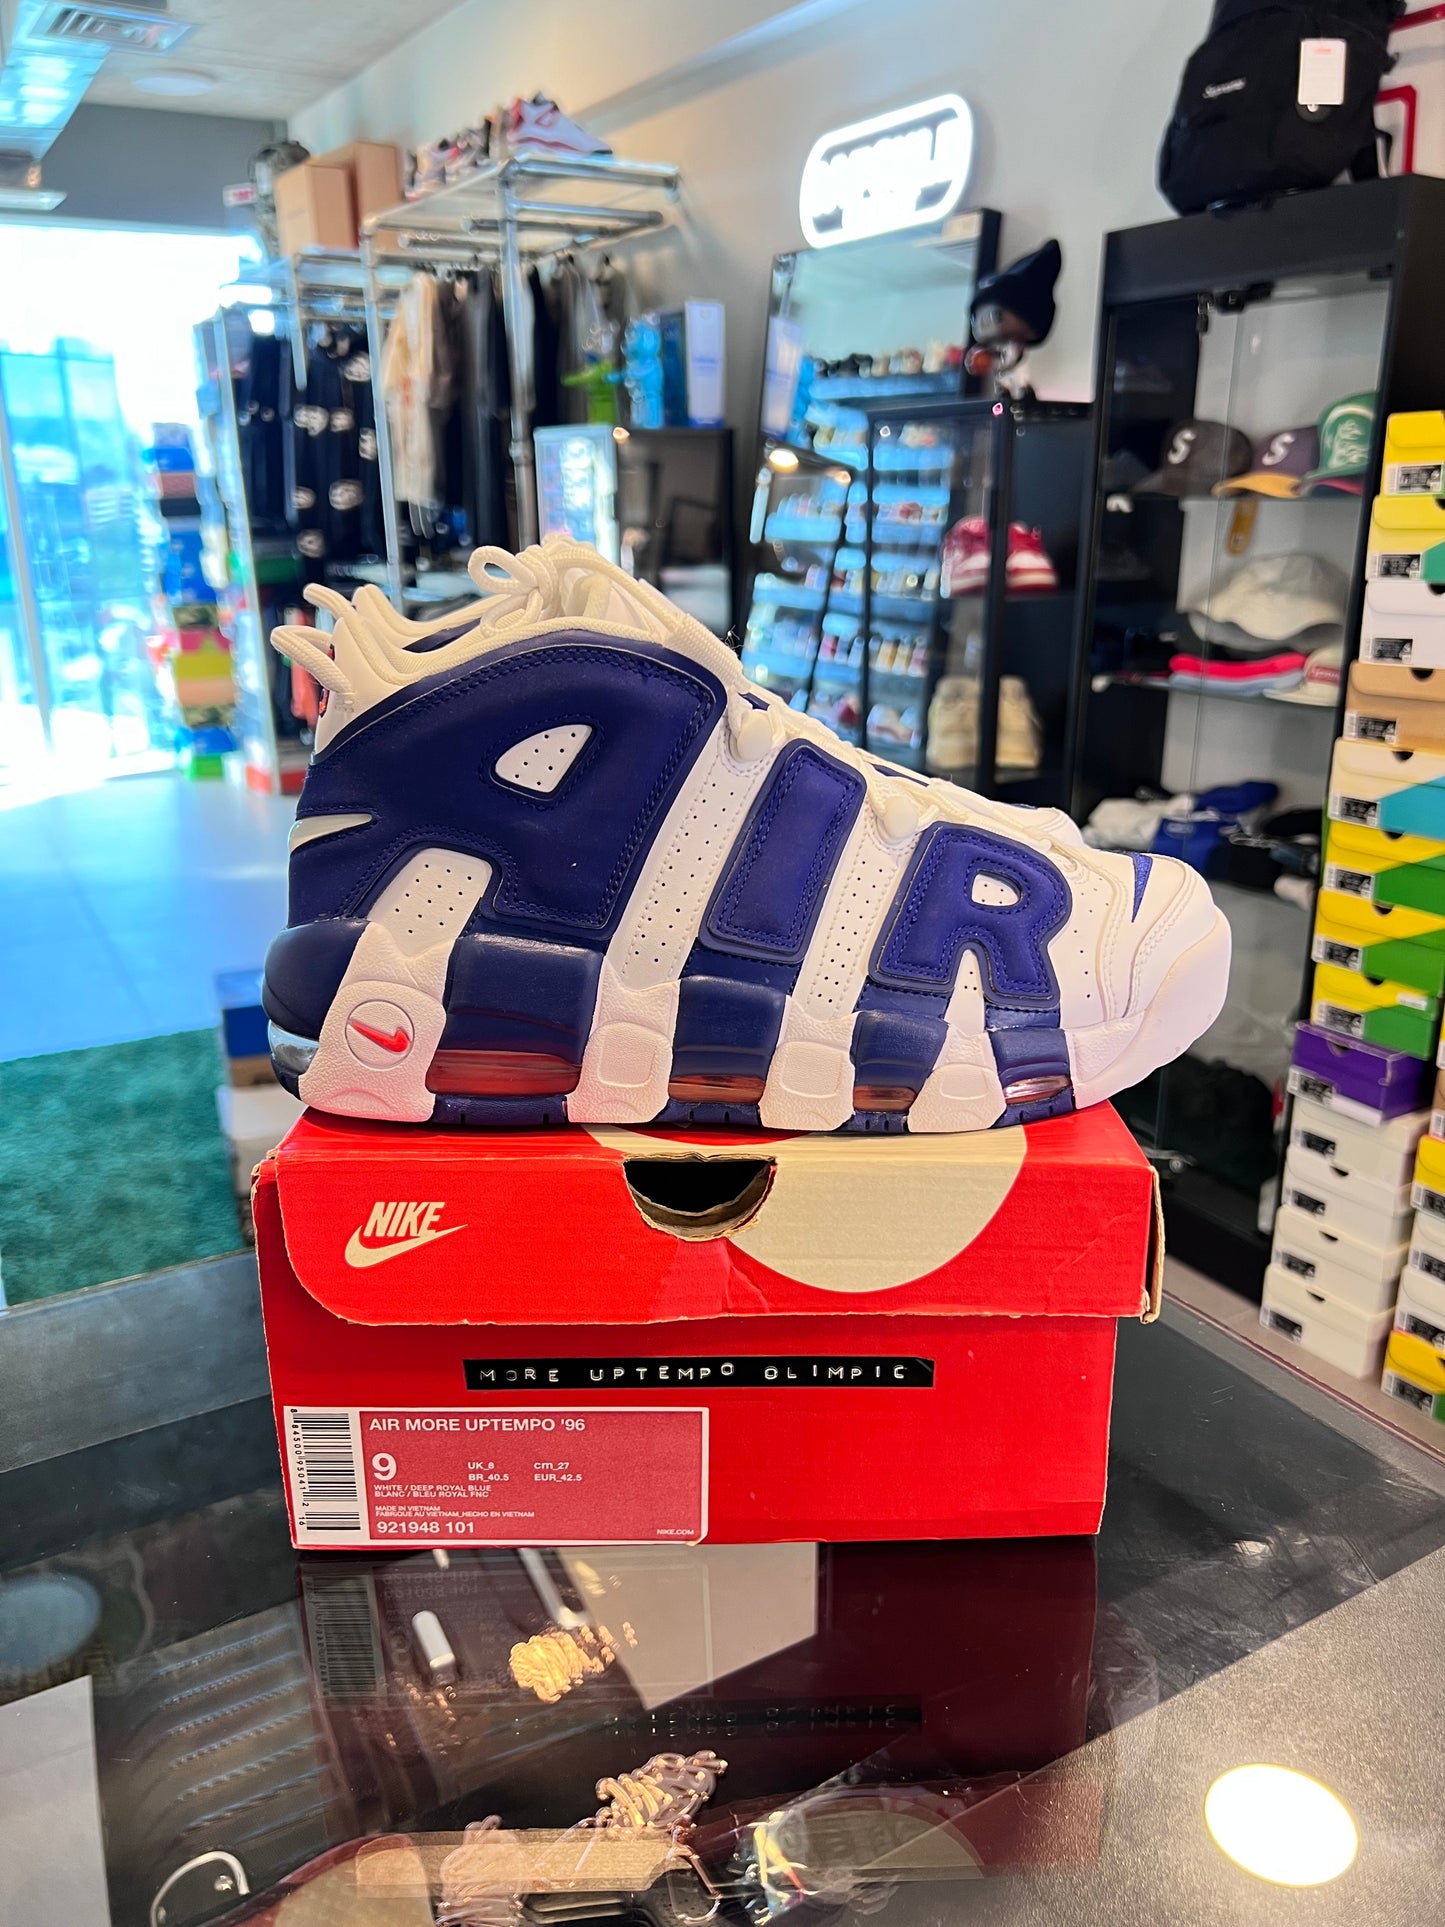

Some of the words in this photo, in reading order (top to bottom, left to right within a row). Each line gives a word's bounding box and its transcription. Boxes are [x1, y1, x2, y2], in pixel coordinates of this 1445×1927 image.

[1167, 428, 1197, 465] S
[1261, 432, 1296, 466] S
[288, 630, 1070, 1007] AIR
[363, 1201, 446, 1238] NIKE
[479, 1366, 560, 1383] MORE
[589, 1362, 735, 1382] UPTEMPO
[763, 1364, 908, 1381] OLIMPIC
[369, 1418, 400, 1431] AIR
[405, 1418, 460, 1431] MORE
[465, 1418, 556, 1431] UPTEMPO
[560, 1418, 586, 1431] '96
[371, 1452, 397, 1481] 9
[467, 1461, 495, 1471] UK_8
[468, 1473, 509, 1482] BR_40.5
[534, 1473, 583, 1482] EUR_42.5
[373, 1484, 403, 1492] WHITE
[376, 1521, 440, 1534] 921948
[445, 1521, 475, 1534] 101
